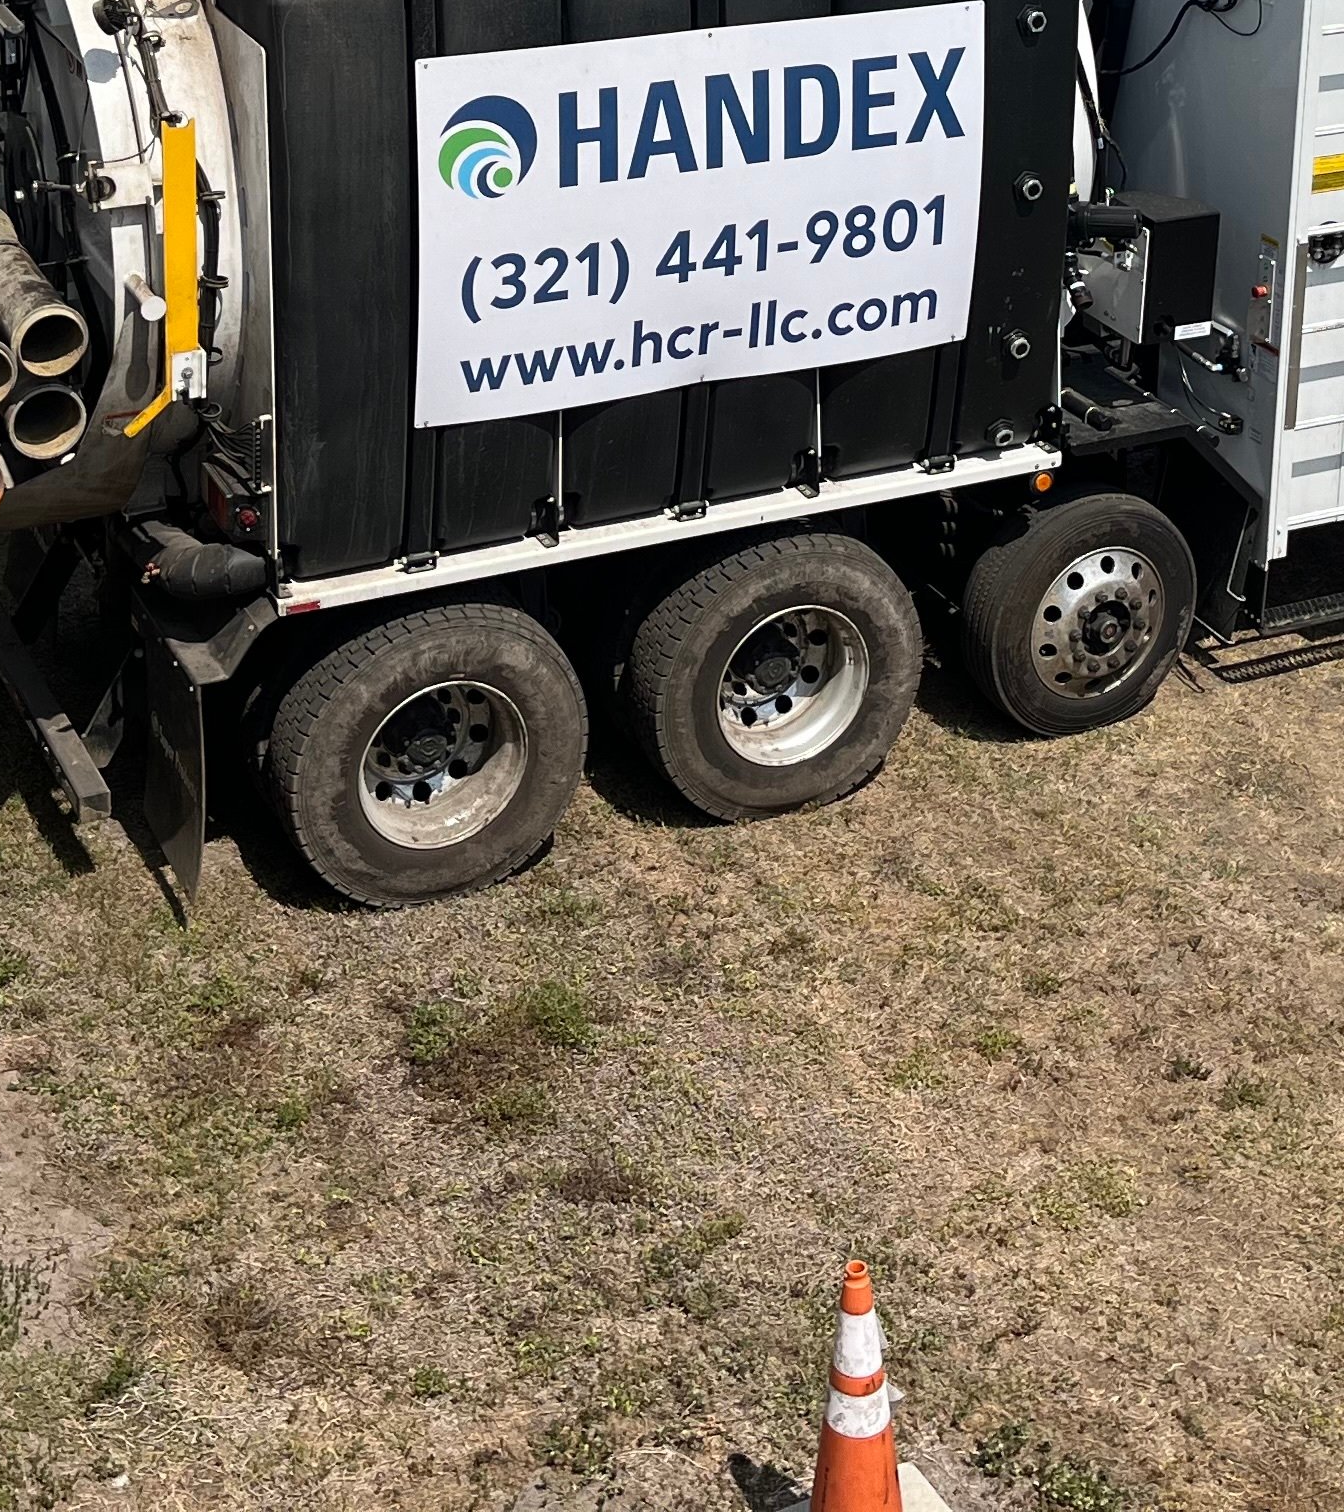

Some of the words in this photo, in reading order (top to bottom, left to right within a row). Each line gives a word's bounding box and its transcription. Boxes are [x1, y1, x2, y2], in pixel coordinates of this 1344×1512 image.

[558, 46, 966, 188] HANDEX
[460, 237, 630, 324] (321)
[655, 194, 946, 284] 441-9801
[460, 287, 937, 393] www.hcr-llc.com
